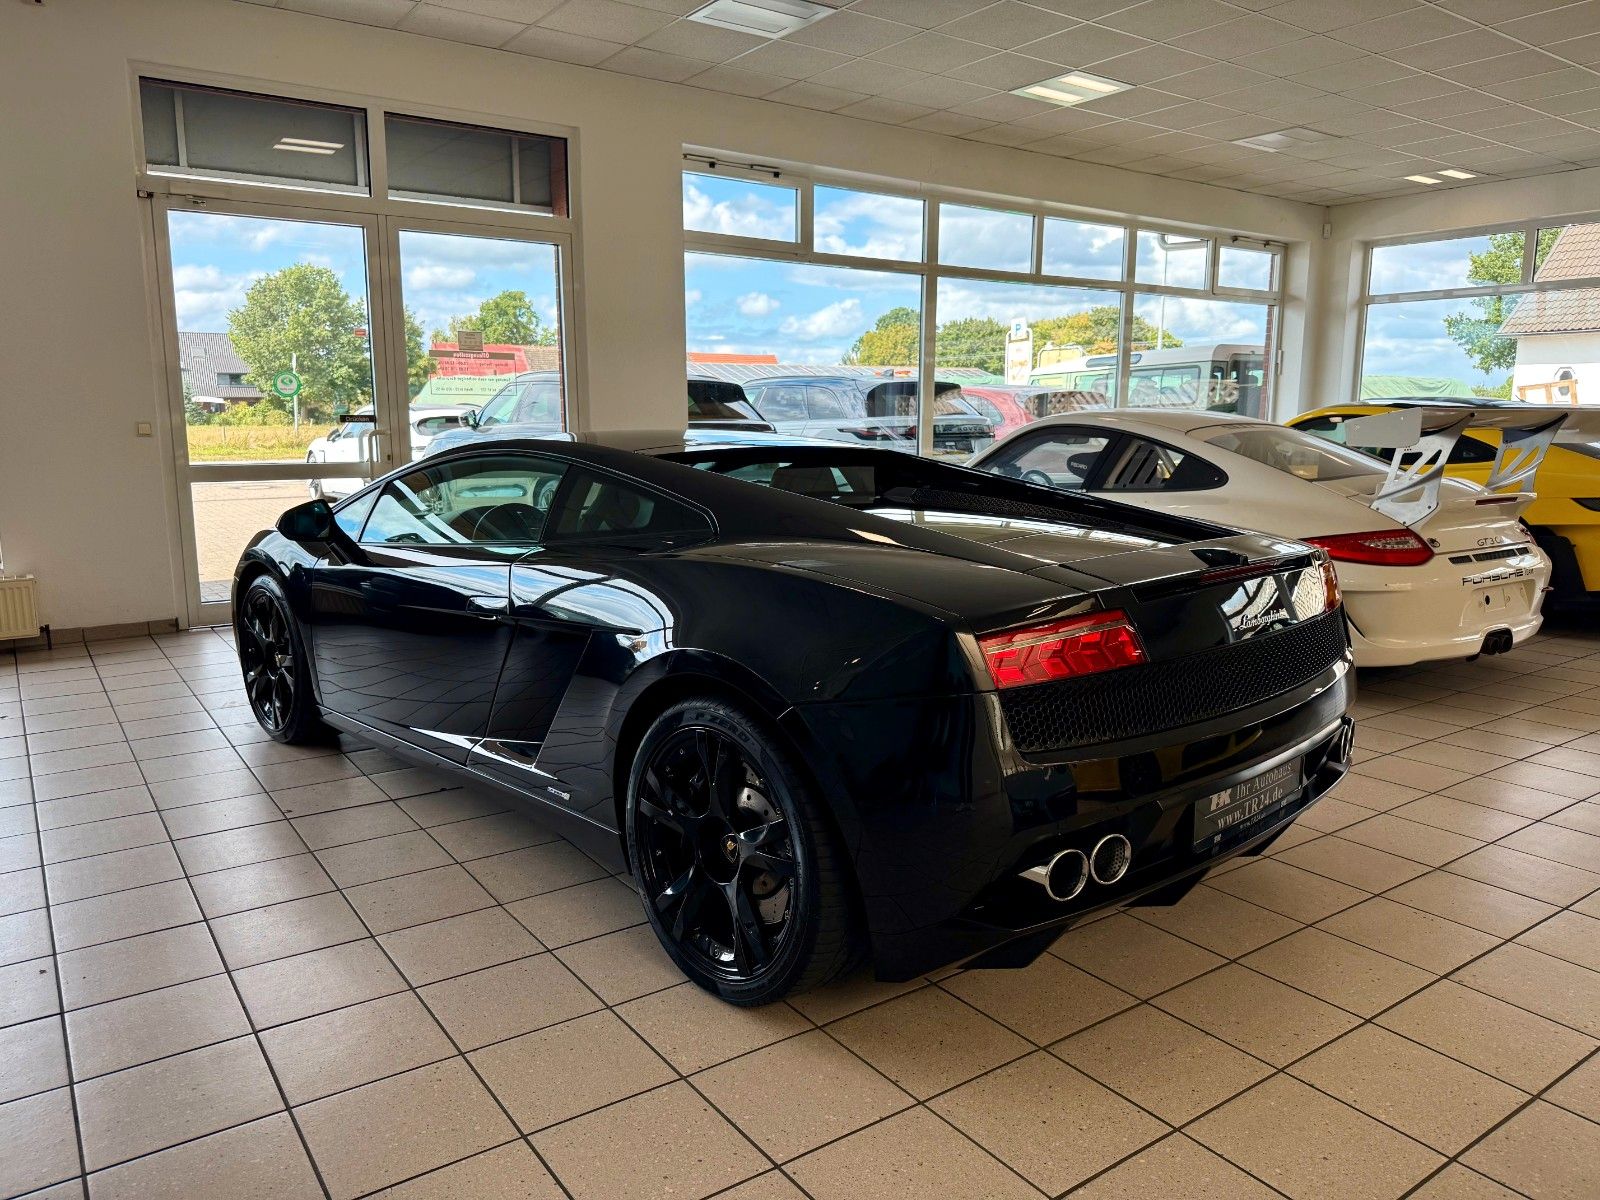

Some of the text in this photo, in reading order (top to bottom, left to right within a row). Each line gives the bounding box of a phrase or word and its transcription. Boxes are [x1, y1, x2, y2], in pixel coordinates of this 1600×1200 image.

[1462, 568, 1524, 586] PORSCHE
[1239, 608, 1285, 630] Lamborghini
[1236, 784, 1251, 799] Ihr
[1253, 762, 1293, 792] Autohaus
[1217, 787, 1283, 830] www.TR24.de
